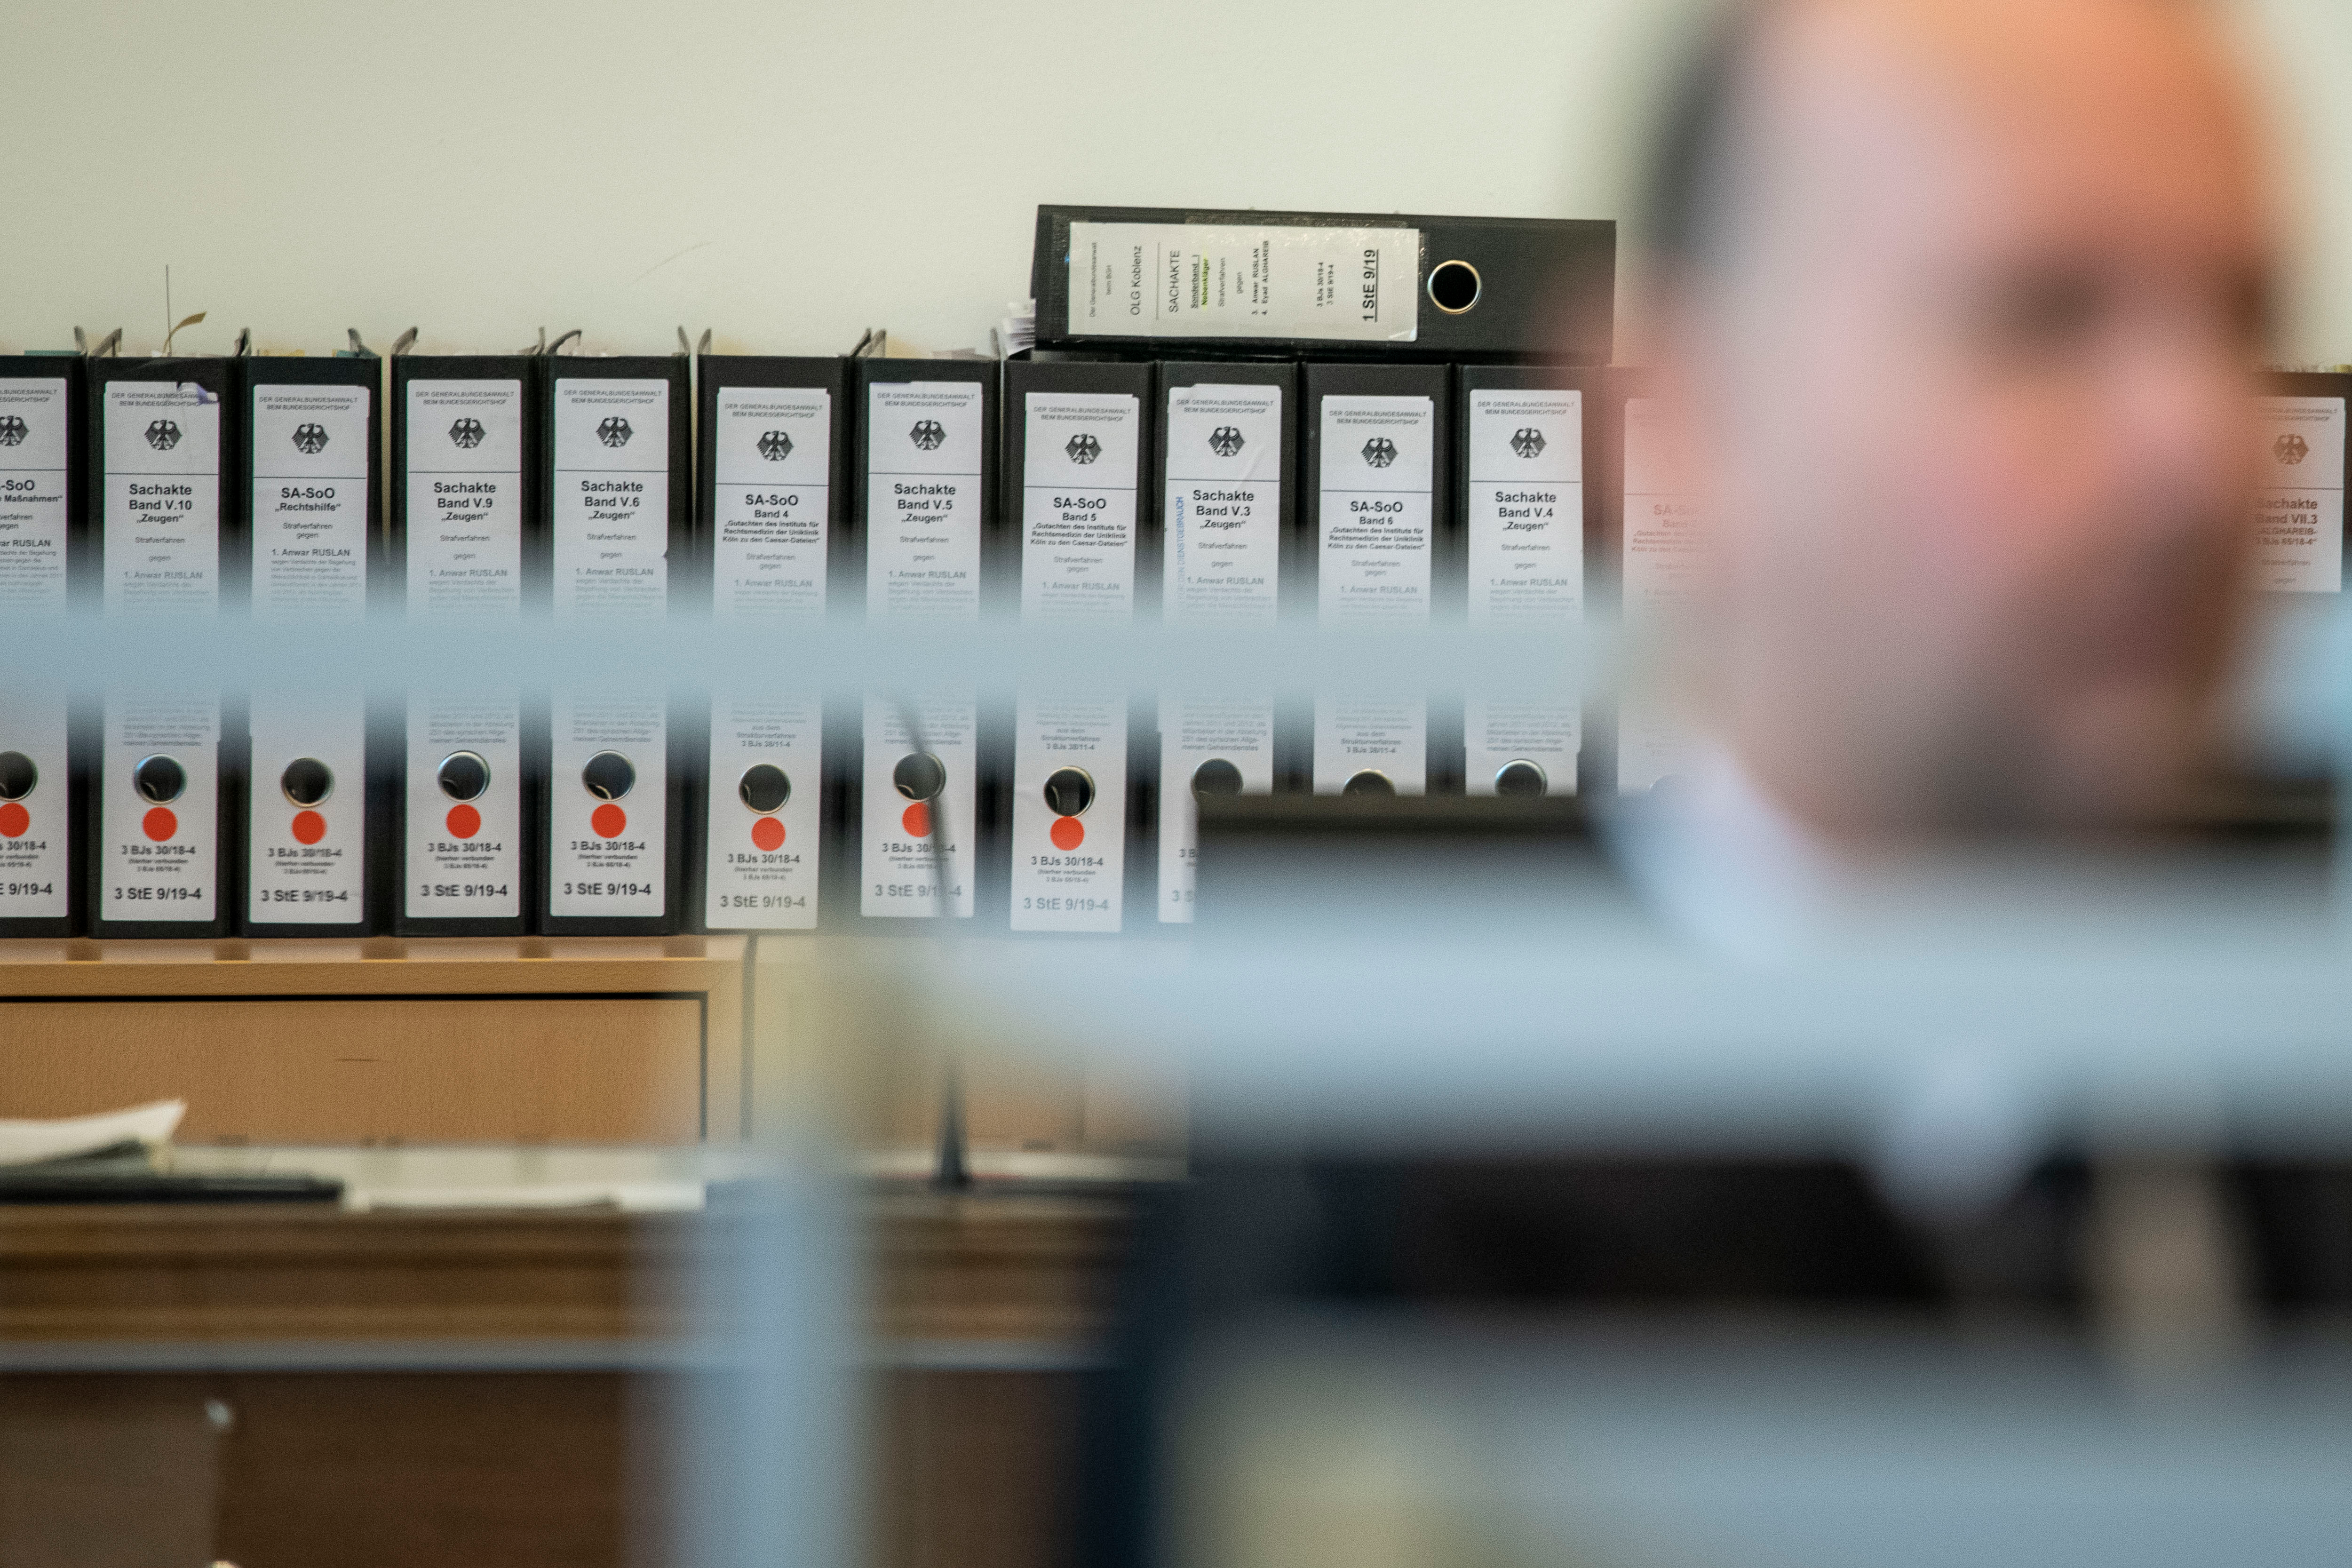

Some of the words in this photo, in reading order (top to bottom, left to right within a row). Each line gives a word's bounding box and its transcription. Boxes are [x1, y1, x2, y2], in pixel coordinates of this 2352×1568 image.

[1131, 246, 1142, 287] Koblenz
[1363, 250, 1375, 279] 9/19
[1168, 250, 1179, 313] SACHAKTE
[1191, 263, 1199, 309] Sonderband
[1201, 259, 1210, 305] Nebenkläger
[1362, 285, 1375, 309] StE
[1130, 291, 1141, 315] OLG
[0, 480, 35, 491] -SoO
[129, 484, 192, 495] Sachakte
[434, 482, 496, 493] Sachakte
[581, 481, 643, 492] Sachakte
[894, 484, 956, 495] Sachakte
[281, 488, 335, 498] SA-SoO
[1193, 490, 1254, 501] Sachakte
[1495, 492, 1556, 503] Sachakte
[129, 501, 161, 510] Band
[166, 501, 192, 510] V.10
[438, 498, 469, 508] Band
[473, 498, 493, 508] V.9
[585, 497, 616, 507] Band
[620, 497, 639, 507] V.6
[745, 494, 798, 506] SA-SoO
[898, 500, 929, 509] Band
[933, 500, 952, 510] V.5
[1053, 498, 1106, 509] SA-SoO
[275, 503, 341, 512] „Rechtshilfe“
[1196, 506, 1227, 516] Band
[1232, 506, 1250, 516] V.3
[1350, 501, 1403, 512] SA-SoO
[442, 513, 488, 522] „Zeugen“
[588, 511, 635, 520] „Zeugen“
[1499, 508, 1530, 517] Band
[1534, 508, 1554, 517] V.4
[137, 515, 184, 524] „Zeugen“
[901, 514, 948, 523] „Zeugen“
[2291, 515, 2318, 524] VII.3
[1200, 520, 1246, 529] „Zeugen“
[1503, 522, 1549, 531] „Zeugen“
[8, 842, 46, 850] 30/18-4
[122, 846, 127, 854] 3
[132, 846, 151, 855] BJs
[156, 846, 196, 855] 30/18-4
[428, 843, 435, 852] 3
[438, 843, 459, 852] BJs
[462, 843, 501, 852] 30/18-4
[571, 842, 577, 851] 3
[581, 842, 601, 851] BJs
[606, 842, 645, 851] 30/18-4
[882, 843, 888, 852] 3
[892, 844, 912, 852] BJs
[916, 844, 955, 852] 30/-4
[268, 848, 274, 857] 3
[278, 848, 298, 857] BJs
[728, 854, 734, 863] 3
[738, 854, 757, 863] BJs
[762, 854, 800, 863] 30/18-4
[1031, 856, 1037, 865] 3
[1041, 857, 1061, 866] BJs
[1065, 857, 1103, 866] 30/18-4
[9, 883, 52, 895] 9/19-4
[115, 888, 122, 899] 3
[127, 888, 152, 899] StE
[157, 888, 202, 899] 9/19-4
[421, 885, 429, 897] 3
[435, 885, 460, 897] StE
[465, 885, 508, 897] 9/19-4
[564, 883, 572, 894] 3
[578, 883, 602, 895] StE
[608, 883, 652, 895] 9/19-4
[875, 885, 883, 897] 3
[888, 885, 913, 897] StE
[262, 890, 269, 901] 3
[274, 890, 299, 901] StE
[303, 890, 348, 902] 9/19-4
[721, 896, 728, 907] 3
[733, 896, 758, 907] StE
[763, 896, 805, 907] 9/19-4
[1024, 898, 1031, 909] 3
[1036, 898, 1060, 909] StE
[1065, 899, 1108, 910] 9/19-4
